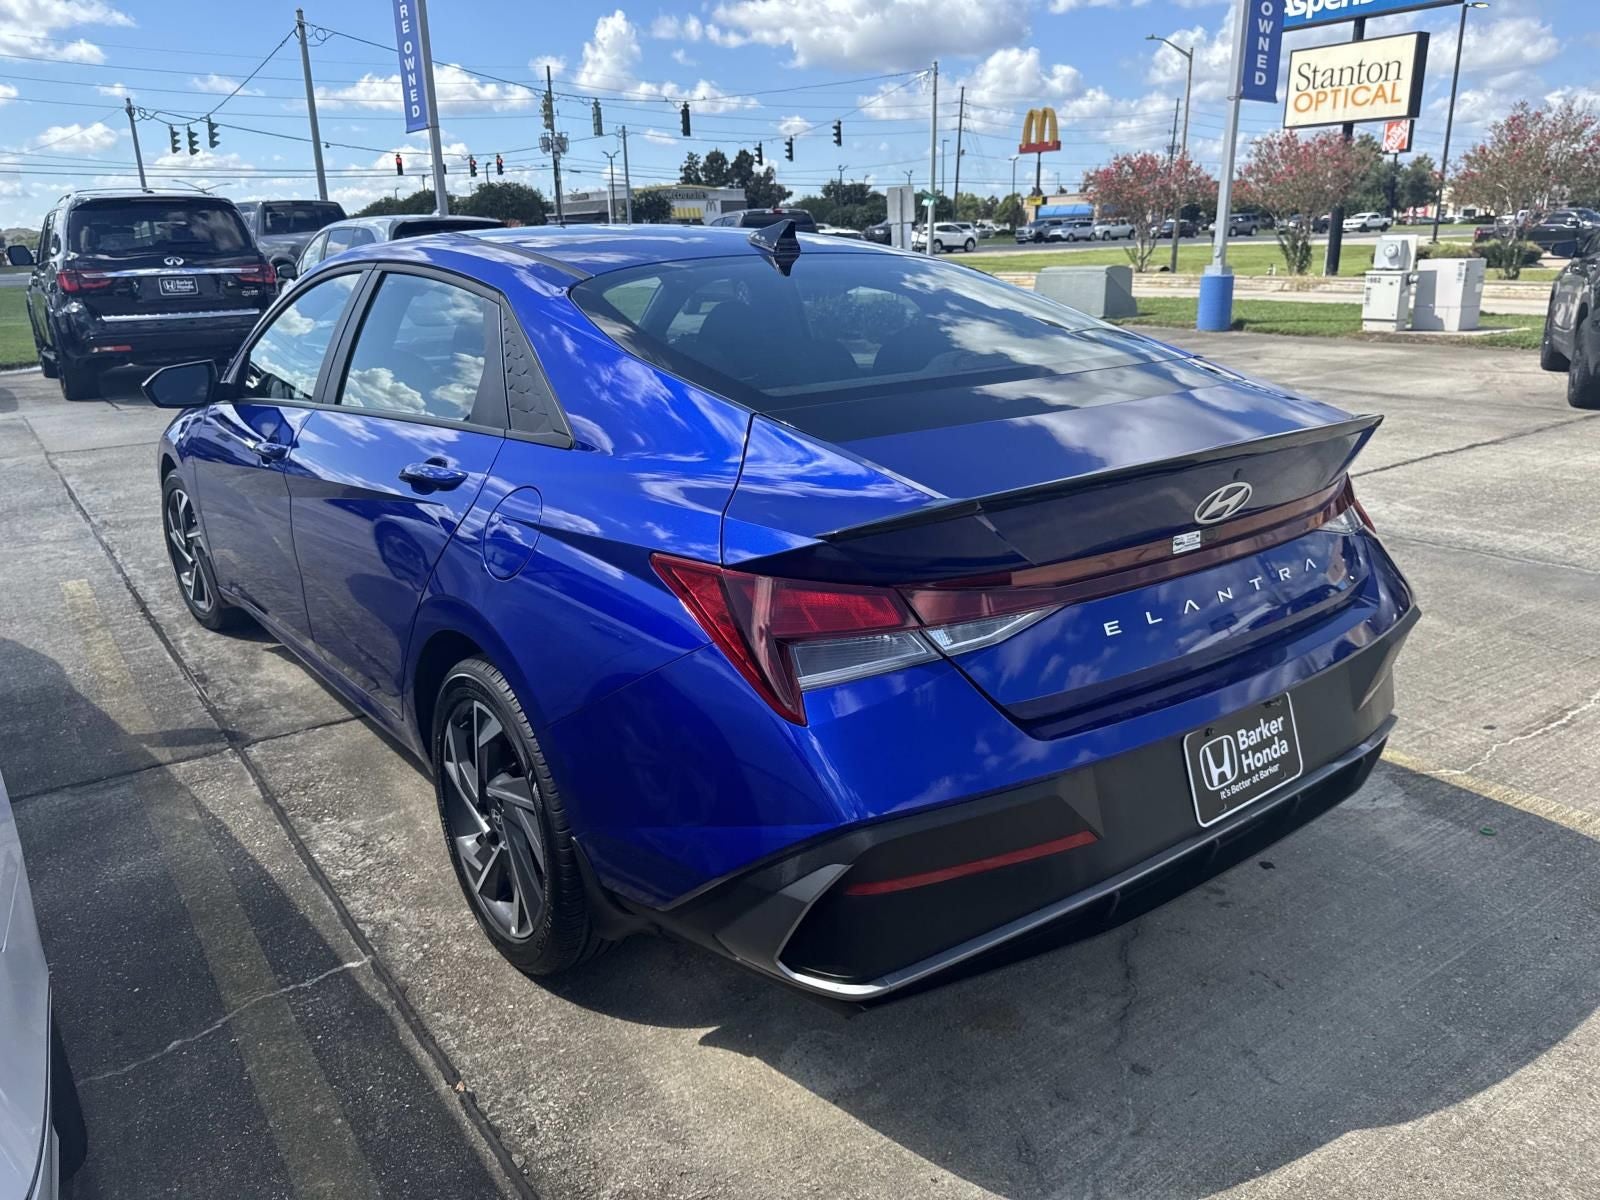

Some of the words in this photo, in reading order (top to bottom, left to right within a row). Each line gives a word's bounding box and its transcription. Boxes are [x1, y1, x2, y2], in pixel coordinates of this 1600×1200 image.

[399, 0, 410, 34] RE
[1254, 1, 1274, 86] OWNED
[404, 41, 420, 118] OWNED
[1295, 58, 1403, 92] Stanton
[1293, 82, 1402, 113] OPTICAL
[1103, 558, 1317, 636] ELANTRA
[1237, 716, 1284, 750] Barker
[1241, 736, 1289, 774] Honda
[1220, 787, 1231, 800] It's
[1231, 778, 1251, 794] Better
[1252, 774, 1260, 784] at
[1259, 764, 1279, 779] Barker
